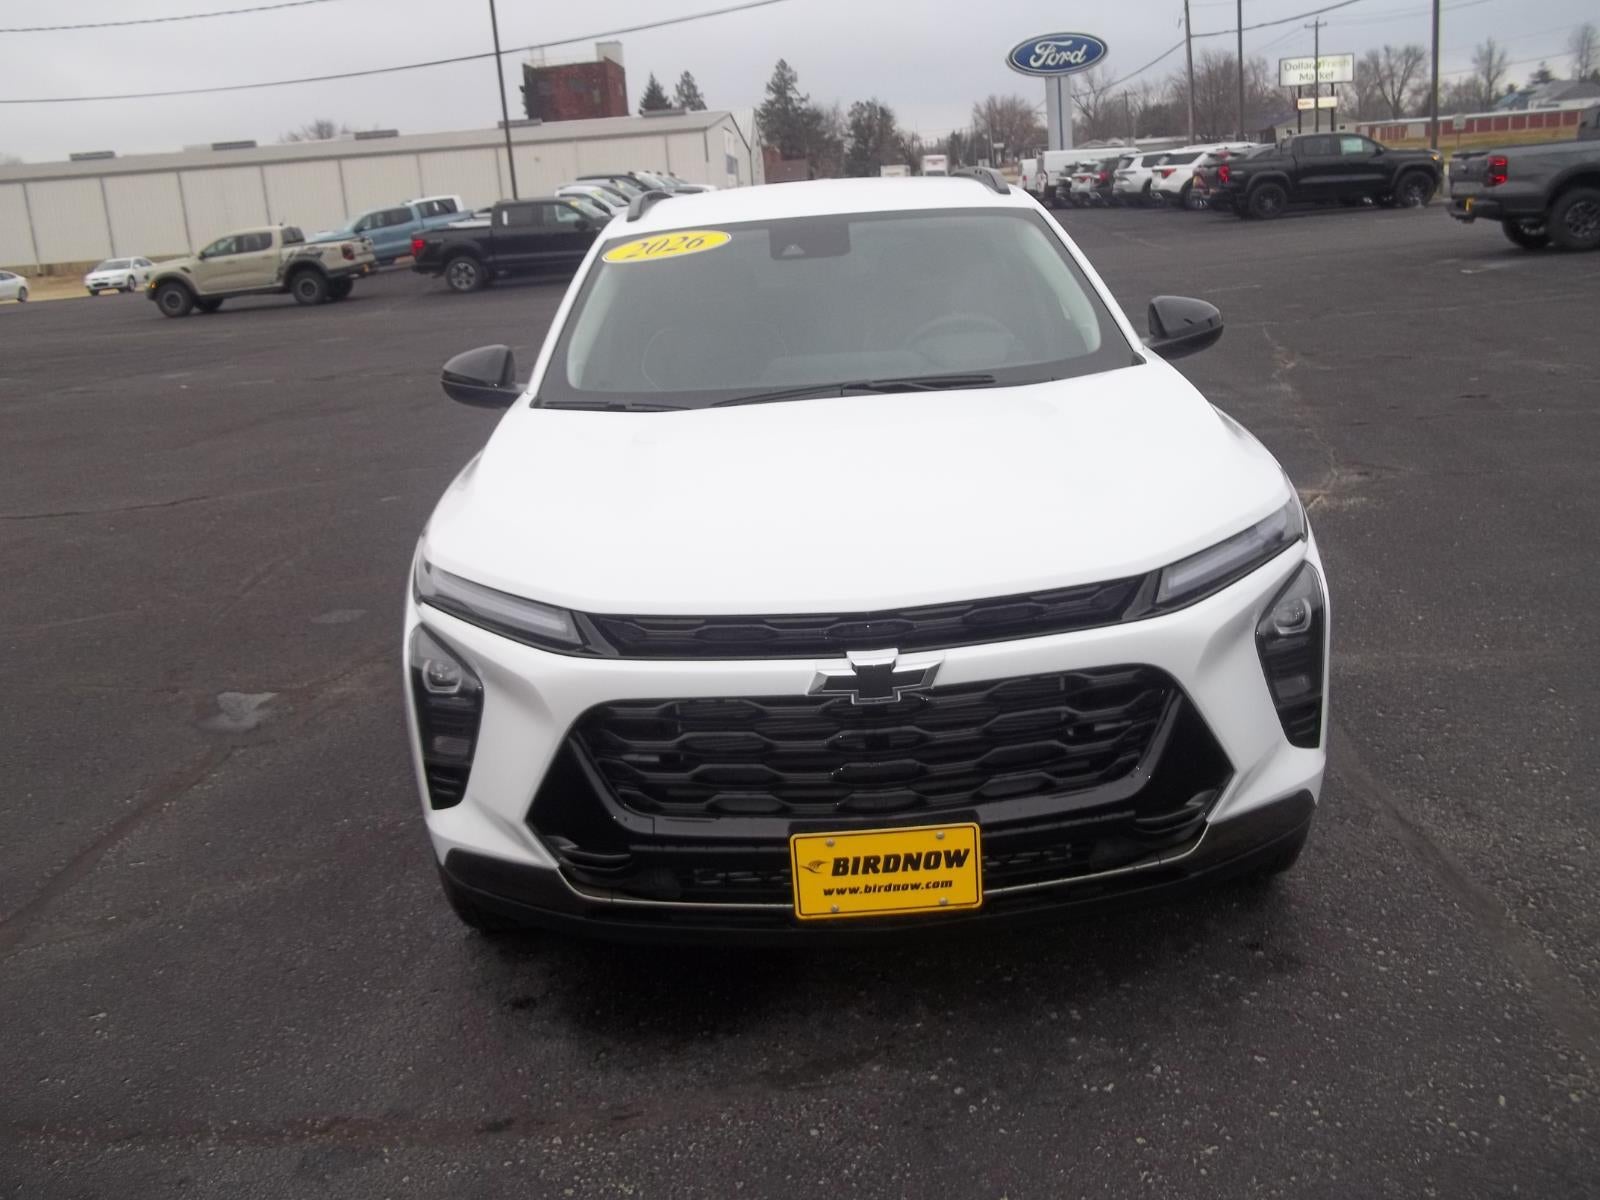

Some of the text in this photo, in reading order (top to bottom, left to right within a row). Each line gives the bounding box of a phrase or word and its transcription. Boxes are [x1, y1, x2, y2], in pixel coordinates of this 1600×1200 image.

[1030, 40, 1087, 67] Ford
[1284, 60, 1314, 72] Dollar
[1299, 71, 1334, 80] Maket
[625, 236, 705, 258] 2026
[831, 849, 970, 876] BIRDNOW
[823, 880, 953, 896] www.birdnow.com
